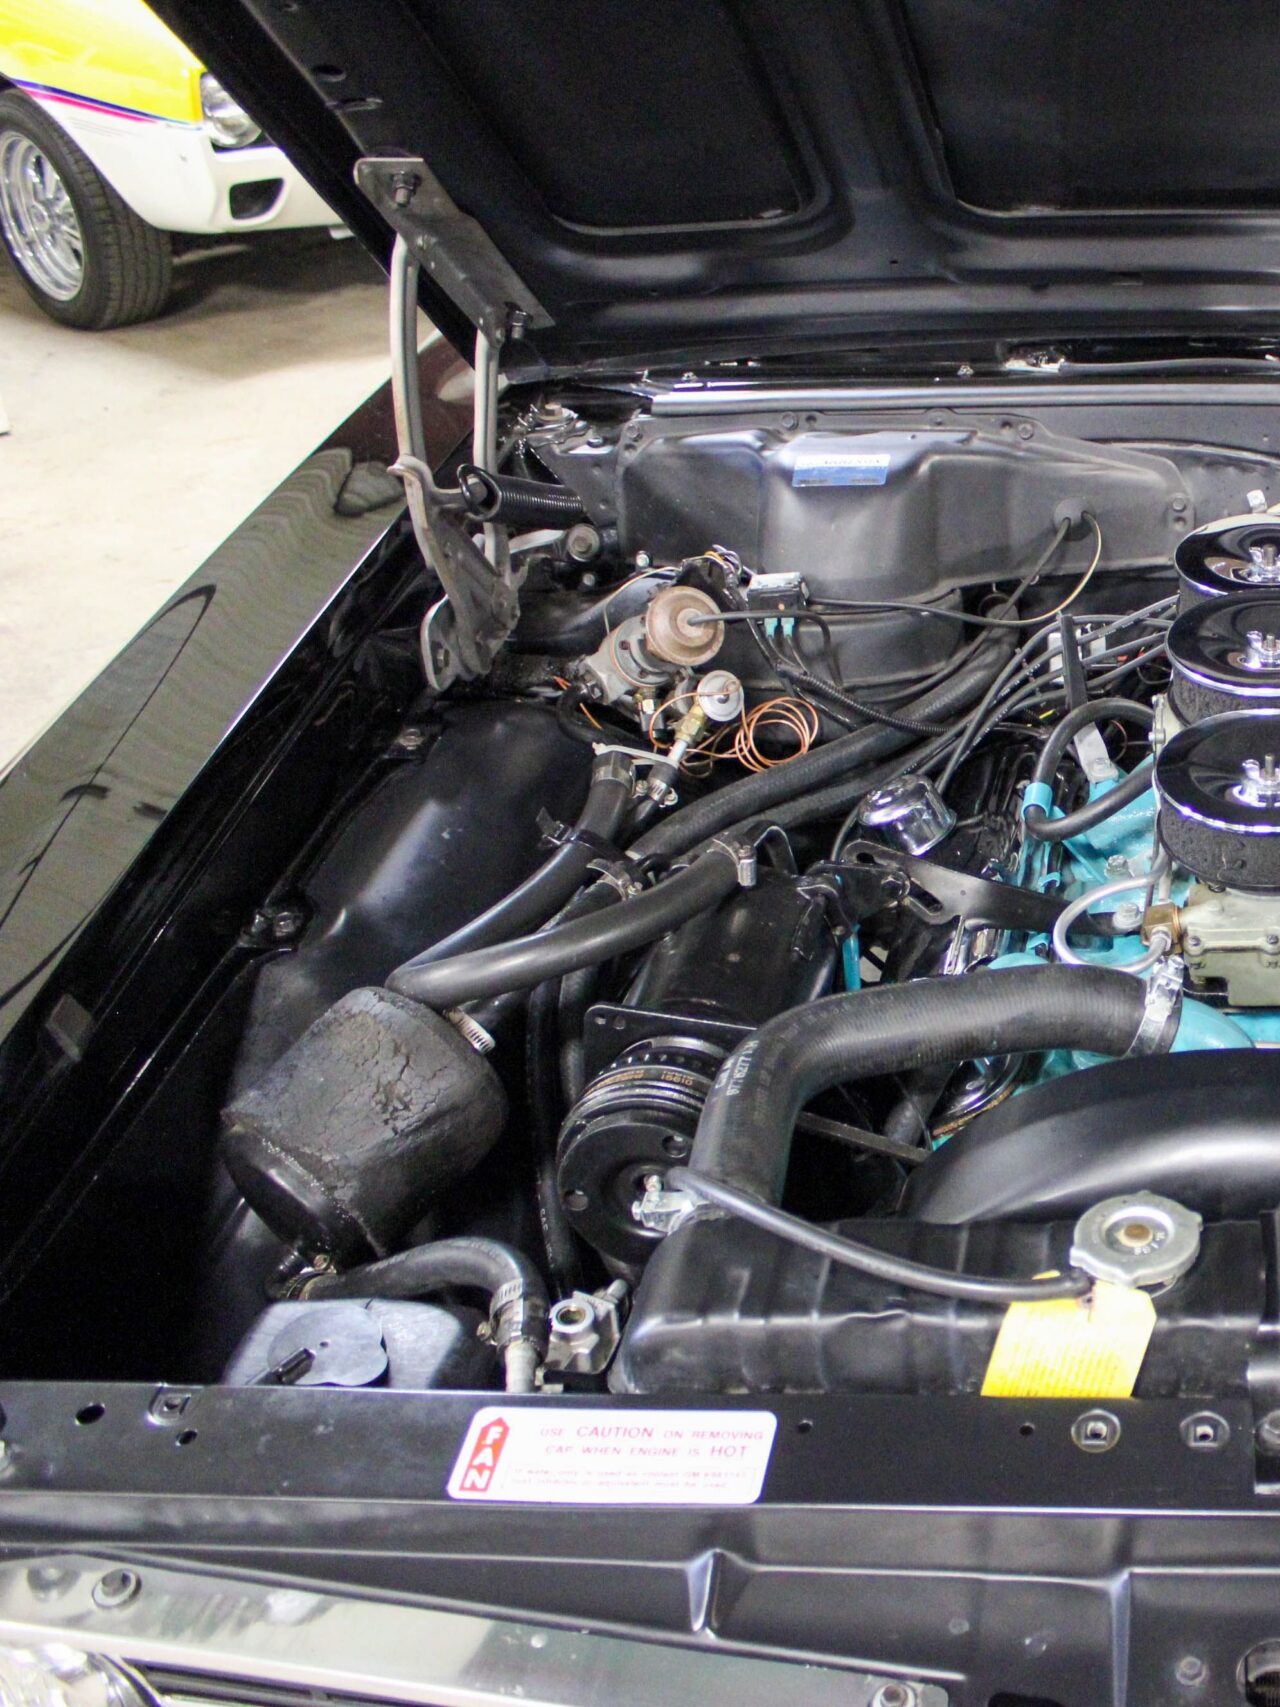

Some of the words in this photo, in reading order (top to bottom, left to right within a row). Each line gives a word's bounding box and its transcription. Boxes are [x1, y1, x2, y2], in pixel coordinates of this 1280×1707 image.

[539, 1428, 565, 1438] USE
[576, 1426, 654, 1438] CAUTION
[664, 1430, 684, 1439] ON
[692, 1430, 764, 1441] REMOVING
[462, 1425, 504, 1490] FAN
[545, 1445, 574, 1455] CAP
[582, 1446, 622, 1455] WHEN
[630, 1447, 679, 1456] ENGINE
[688, 1447, 700, 1457] IS
[710, 1445, 748, 1458] HOT
